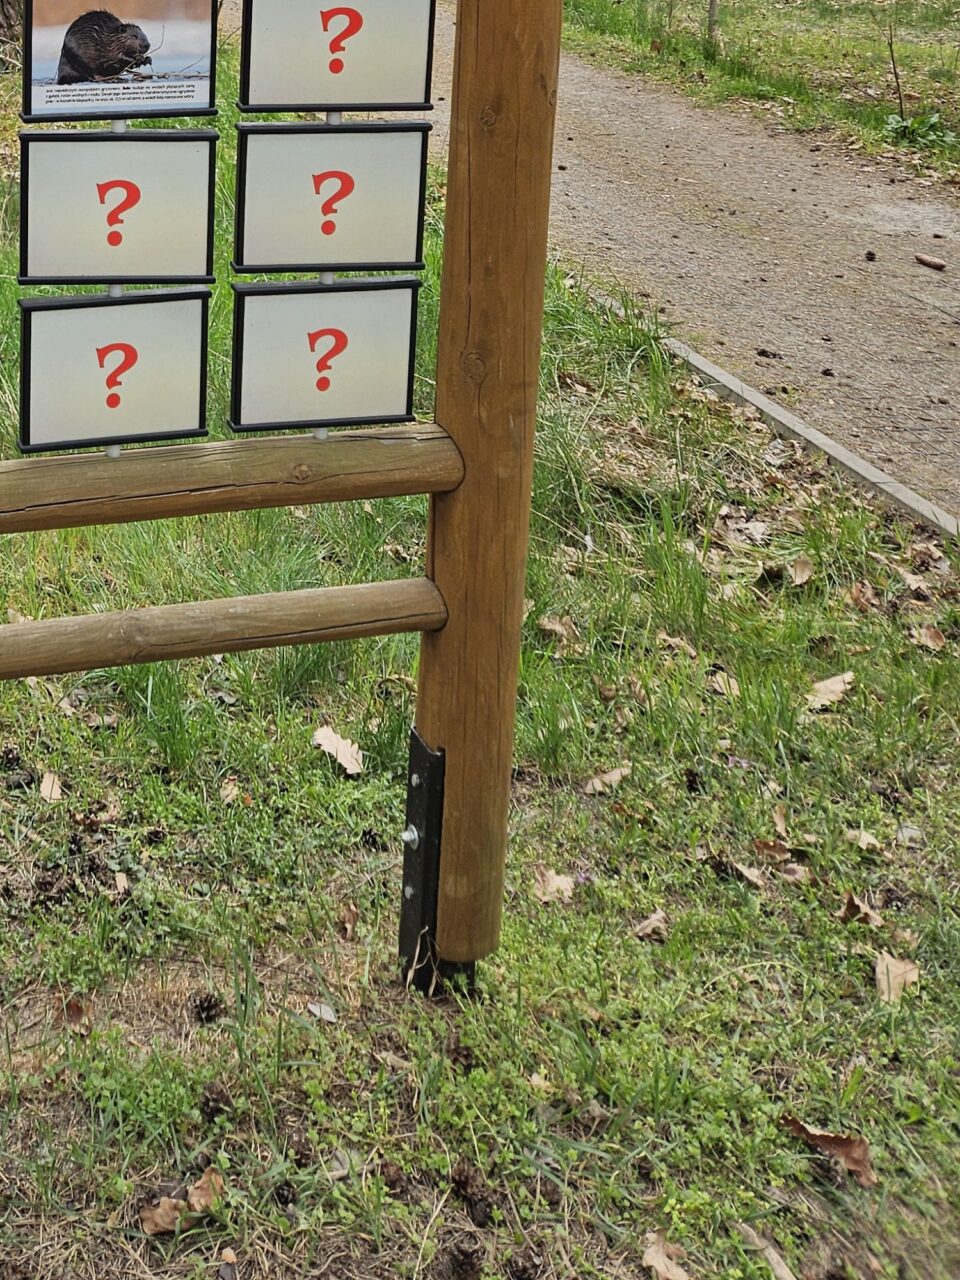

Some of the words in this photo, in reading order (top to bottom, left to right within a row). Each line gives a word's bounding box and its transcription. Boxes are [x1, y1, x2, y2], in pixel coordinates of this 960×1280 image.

[321, 8, 362, 73] ?
[98, 181, 139, 245] ?
[314, 172, 354, 234] ?
[98, 344, 136, 407] ?
[309, 329, 347, 390] ?
